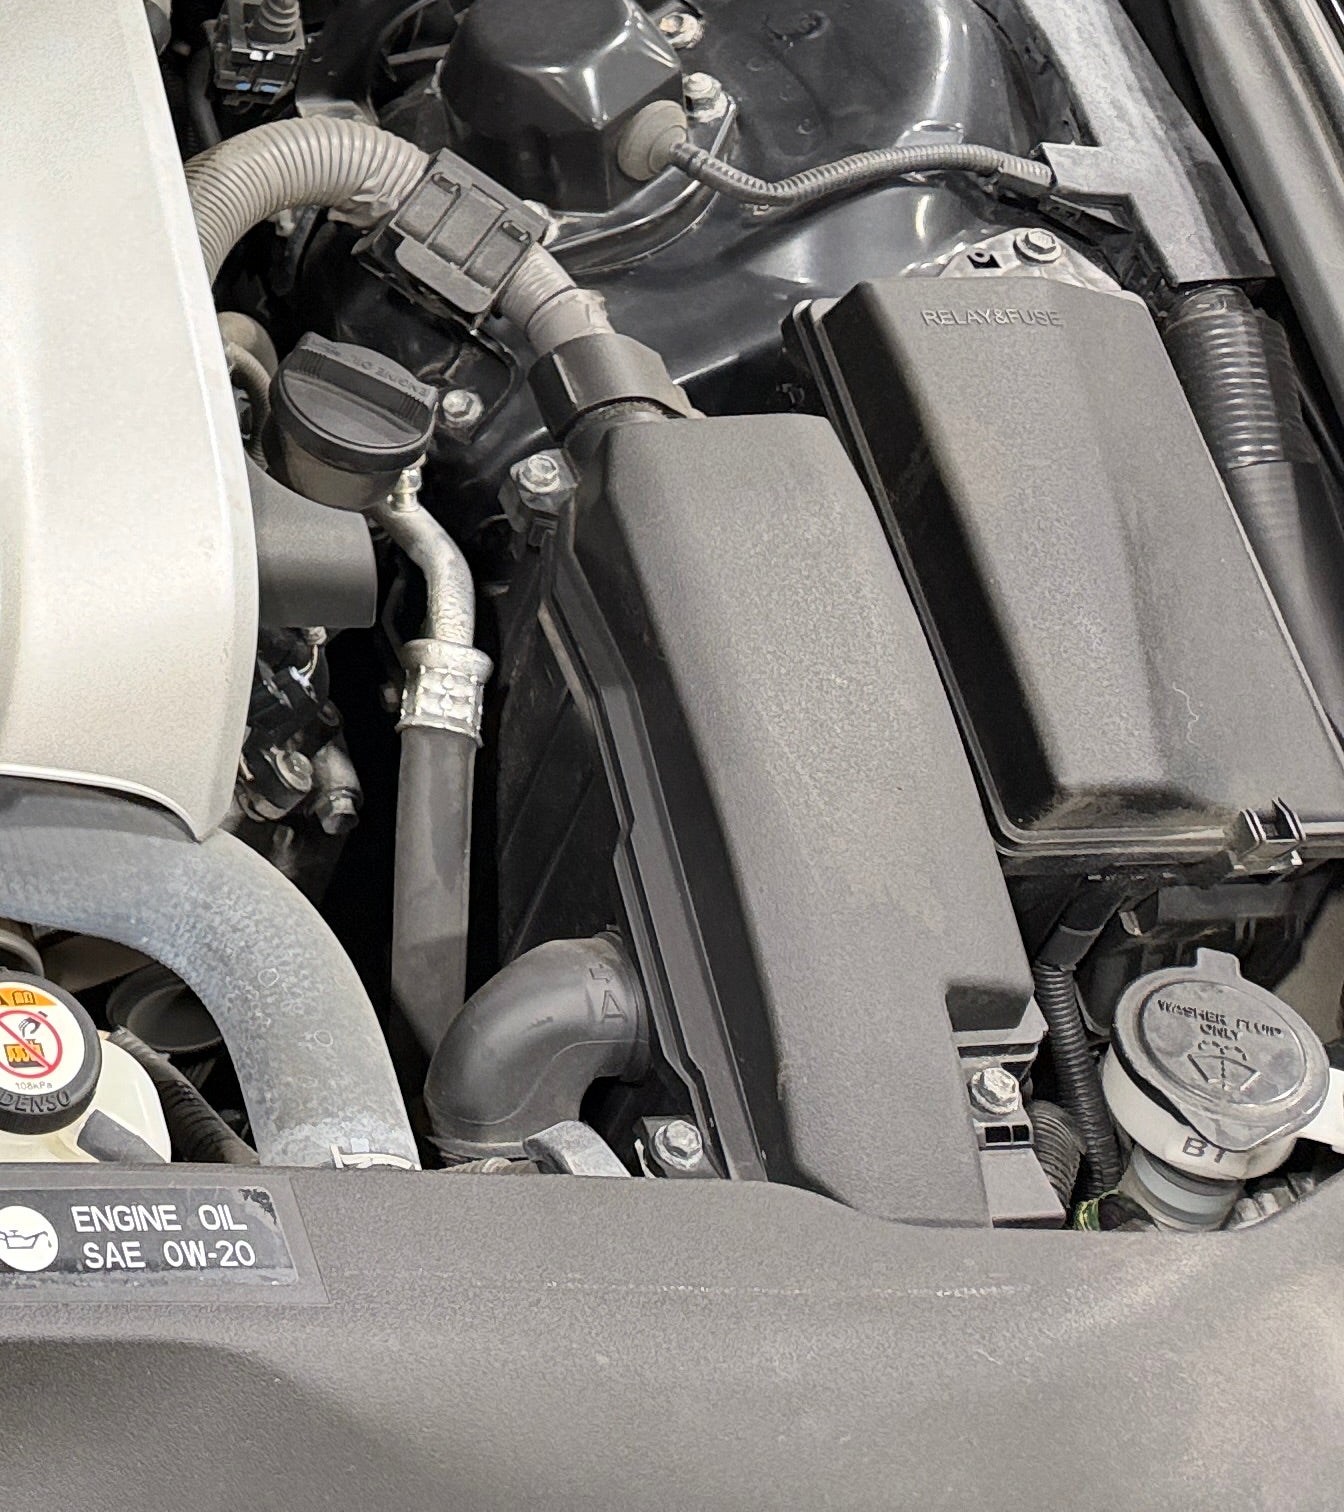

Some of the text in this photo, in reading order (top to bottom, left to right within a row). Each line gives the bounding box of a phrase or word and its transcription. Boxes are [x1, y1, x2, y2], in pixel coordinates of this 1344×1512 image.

[920, 308, 1064, 327] RELAY&FUSE
[1157, 999, 1282, 1036] WASHER FLUID
[1199, 1024, 1239, 1041] ONLY
[71, 1203, 248, 1233] ENGINE OIL
[83, 1239, 256, 1269] SAE 0W-20
